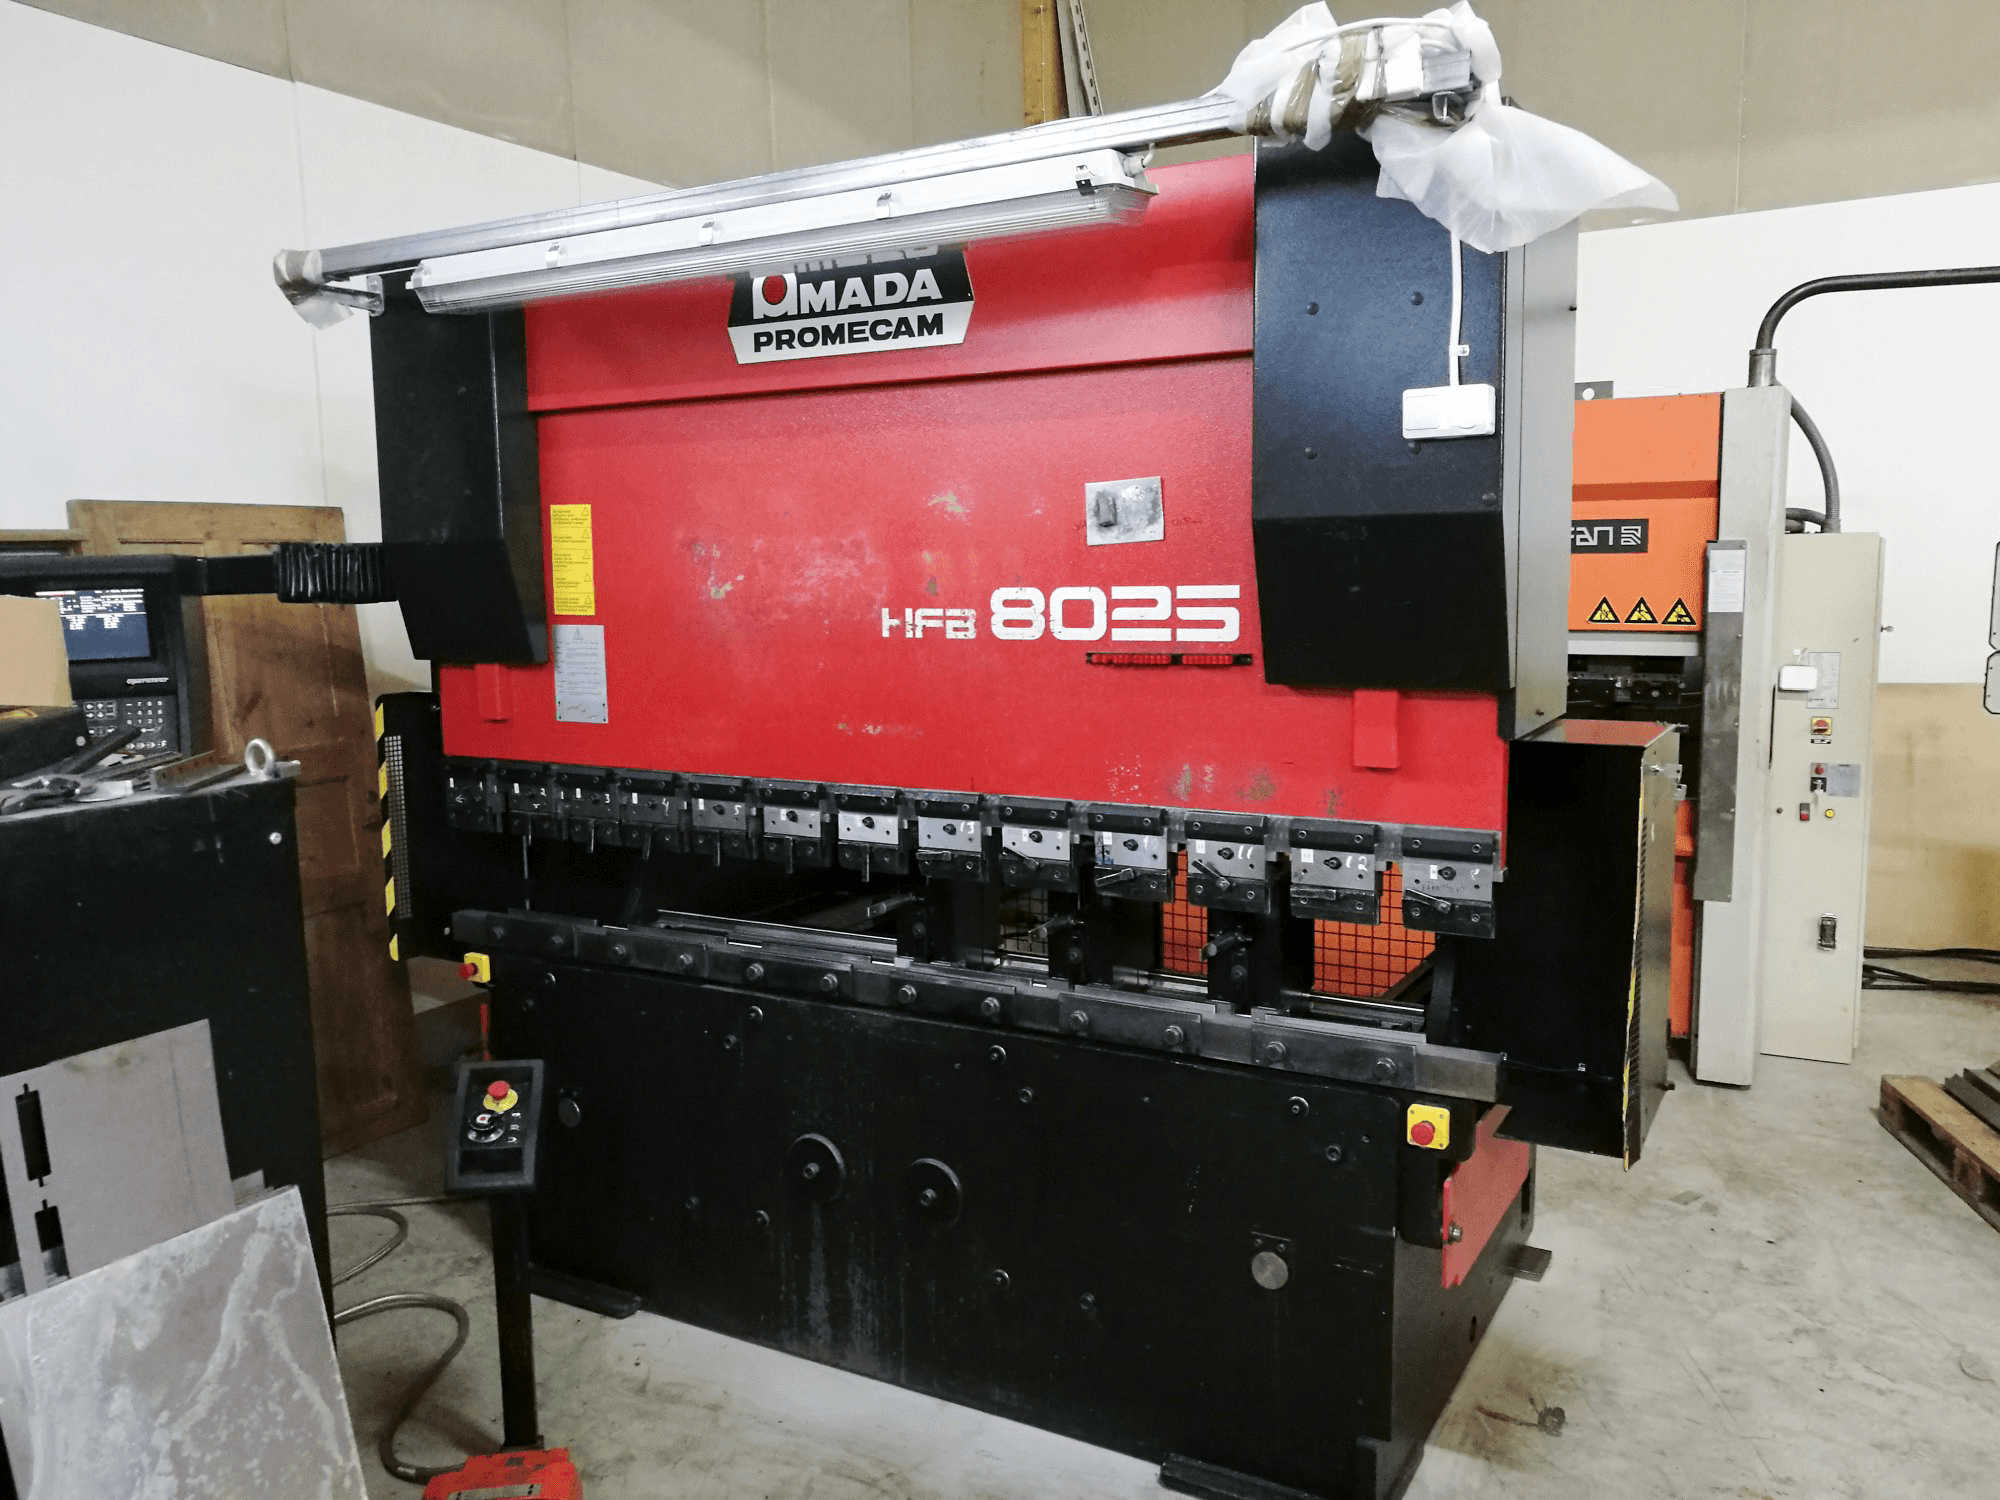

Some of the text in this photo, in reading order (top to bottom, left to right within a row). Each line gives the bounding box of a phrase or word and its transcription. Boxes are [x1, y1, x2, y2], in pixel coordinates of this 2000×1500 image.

[752, 268, 943, 320] AMADA
[753, 312, 944, 353] PROMECAM
[881, 584, 1241, 642] HFB 8025
[1346, 855, 1369, 872] 12
